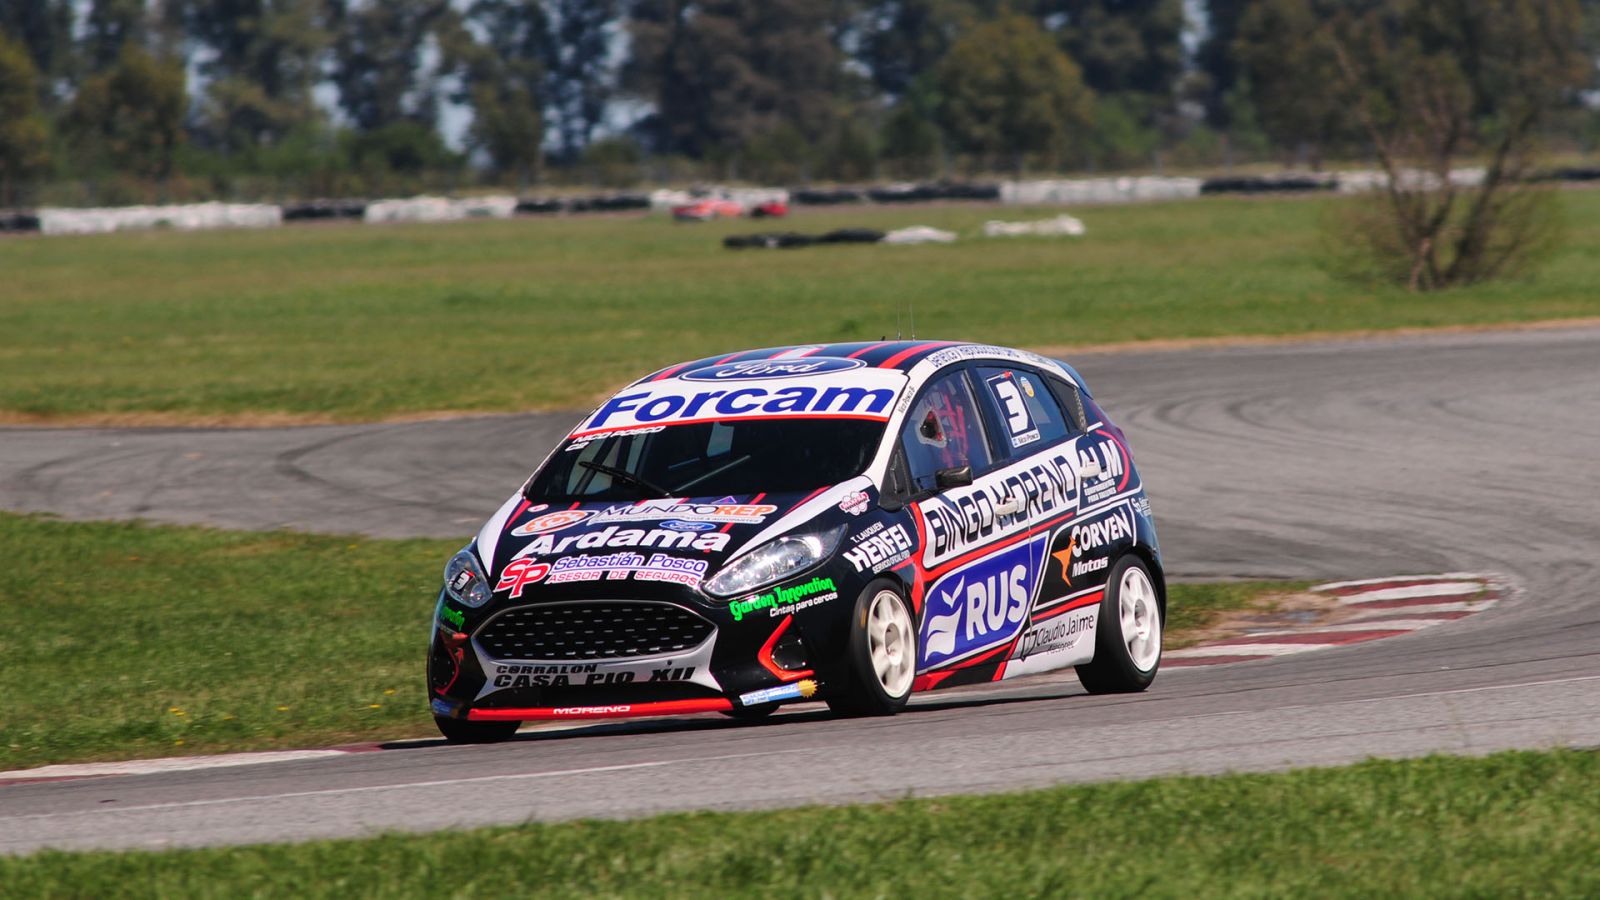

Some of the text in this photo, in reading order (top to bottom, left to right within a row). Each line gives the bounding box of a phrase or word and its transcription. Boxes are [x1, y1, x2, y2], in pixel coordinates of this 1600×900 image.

[716, 358, 826, 378] Ford
[587, 386, 895, 429] Forcam
[995, 380, 1028, 434] 3
[572, 431, 613, 444] NICO
[925, 455, 1078, 558] BINGO MORENO
[511, 525, 732, 560] Ardama
[1071, 506, 1133, 557] CORVEN
[494, 558, 551, 599] SP
[651, 554, 706, 572] Posco
[549, 571, 698, 587] ASESOR DE SEGUROS
[1072, 556, 1109, 577] Motos
[774, 577, 837, 604] Innovation
[966, 565, 1027, 641] RUS
[1036, 614, 1095, 647] Claudio Jaime
[493, 666, 696, 687] CASA PIO XII
[553, 705, 631, 714] MORENO
